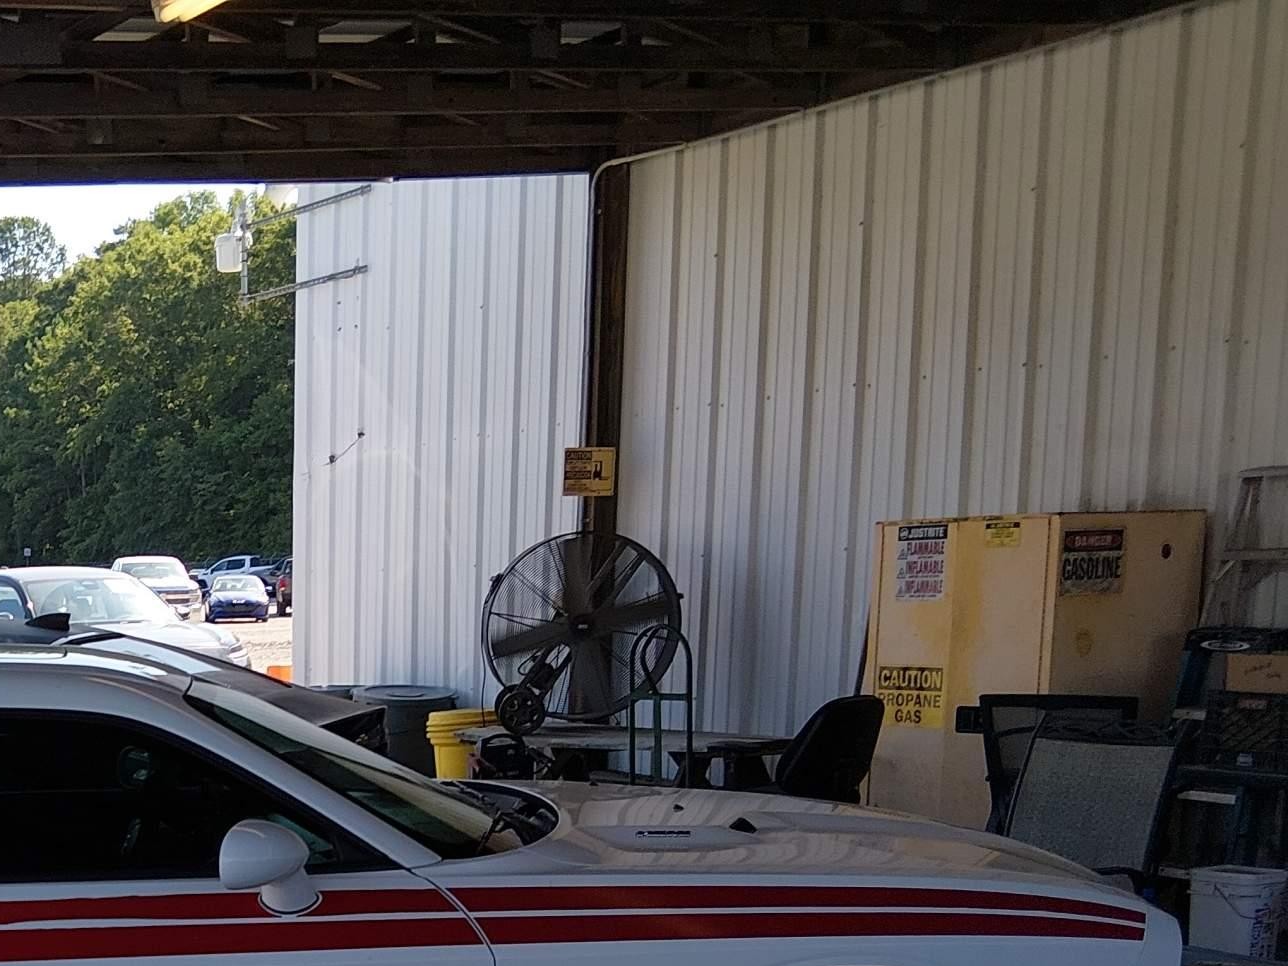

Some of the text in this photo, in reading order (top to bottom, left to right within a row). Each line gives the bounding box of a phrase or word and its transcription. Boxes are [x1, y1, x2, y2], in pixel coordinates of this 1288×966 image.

[906, 541, 945, 555] FLAMMABLE
[1062, 555, 1121, 581] GASOLINE
[881, 669, 942, 689] CAUTION
[878, 692, 942, 709] PROPANE
[895, 708, 922, 724] GAS
